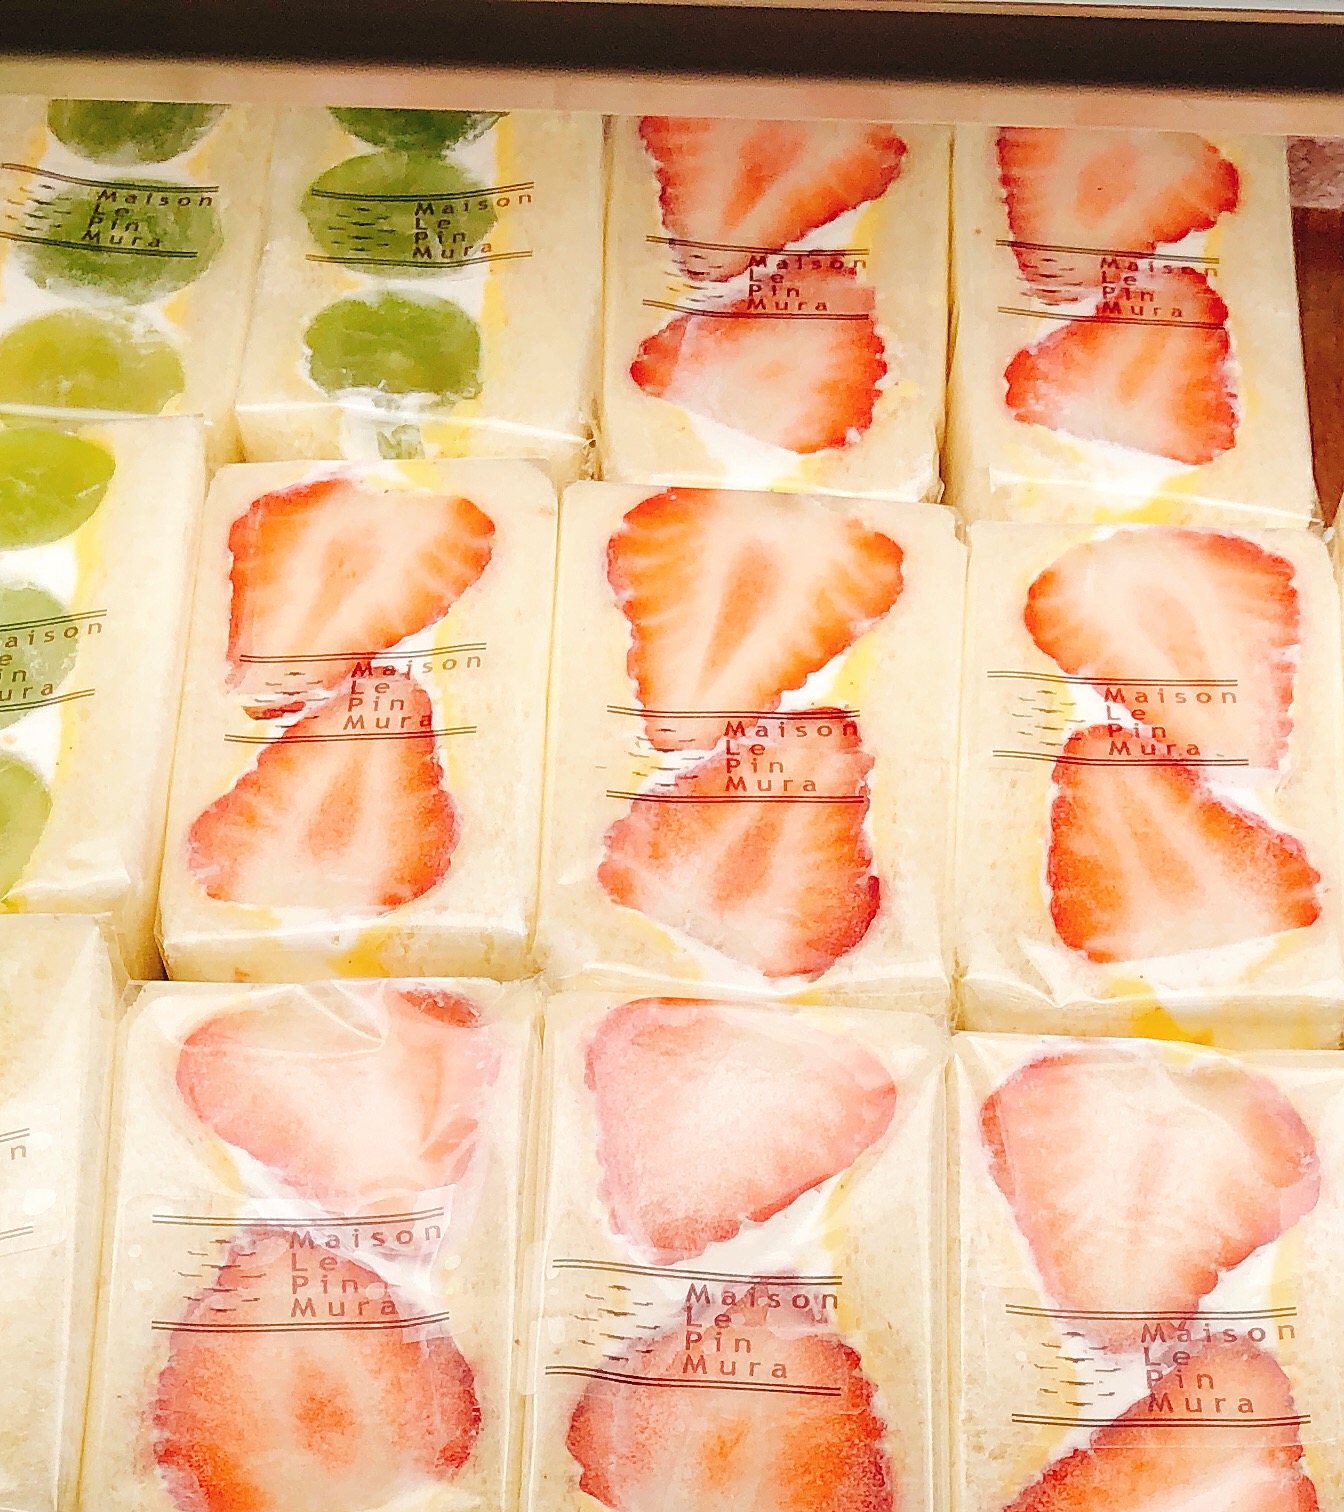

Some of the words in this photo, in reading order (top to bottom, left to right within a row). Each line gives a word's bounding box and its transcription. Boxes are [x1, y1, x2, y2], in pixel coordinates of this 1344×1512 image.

[96, 188, 214, 208] Maison
[414, 192, 533, 217] Maison
[91, 202, 131, 217] Le
[86, 213, 140, 232] Pin
[415, 217, 451, 231] Le
[80, 228, 163, 249] Mura
[414, 229, 466, 245] Pin
[412, 241, 493, 261] Mura
[748, 254, 867, 270] Maison
[1100, 257, 1218, 278] Maison
[749, 270, 785, 285] Le
[1101, 271, 1138, 286] Le
[748, 284, 801, 299] Pin
[1101, 286, 1155, 303] Pin
[746, 298, 828, 312] Mura
[1100, 301, 1183, 318] Mura
[349, 653, 483, 681] Maison
[350, 681, 392, 695] Le
[1103, 687, 1238, 704] Maison
[347, 696, 405, 713] Pin
[1106, 704, 1146, 721] Le
[342, 713, 433, 731] Mura
[723, 720, 859, 738] Maison
[1108, 723, 1167, 740] Pin
[725, 738, 766, 757] Le
[1109, 740, 1201, 756] Mura
[725, 757, 785, 774] Pin
[724, 776, 818, 793] Mura
[288, 1223, 442, 1251] Maison
[290, 1252, 339, 1273] Le
[290, 1274, 358, 1295] Pin
[685, 1282, 839, 1311] Maison
[290, 1297, 398, 1319] Mura
[685, 1305, 732, 1330] Le
[684, 1329, 752, 1354] Pin
[1140, 1322, 1297, 1344] Maison
[682, 1352, 789, 1379] Mura
[1142, 1346, 1192, 1368] Le
[1145, 1368, 1215, 1390] Pin
[1147, 1391, 1255, 1414] Mura
